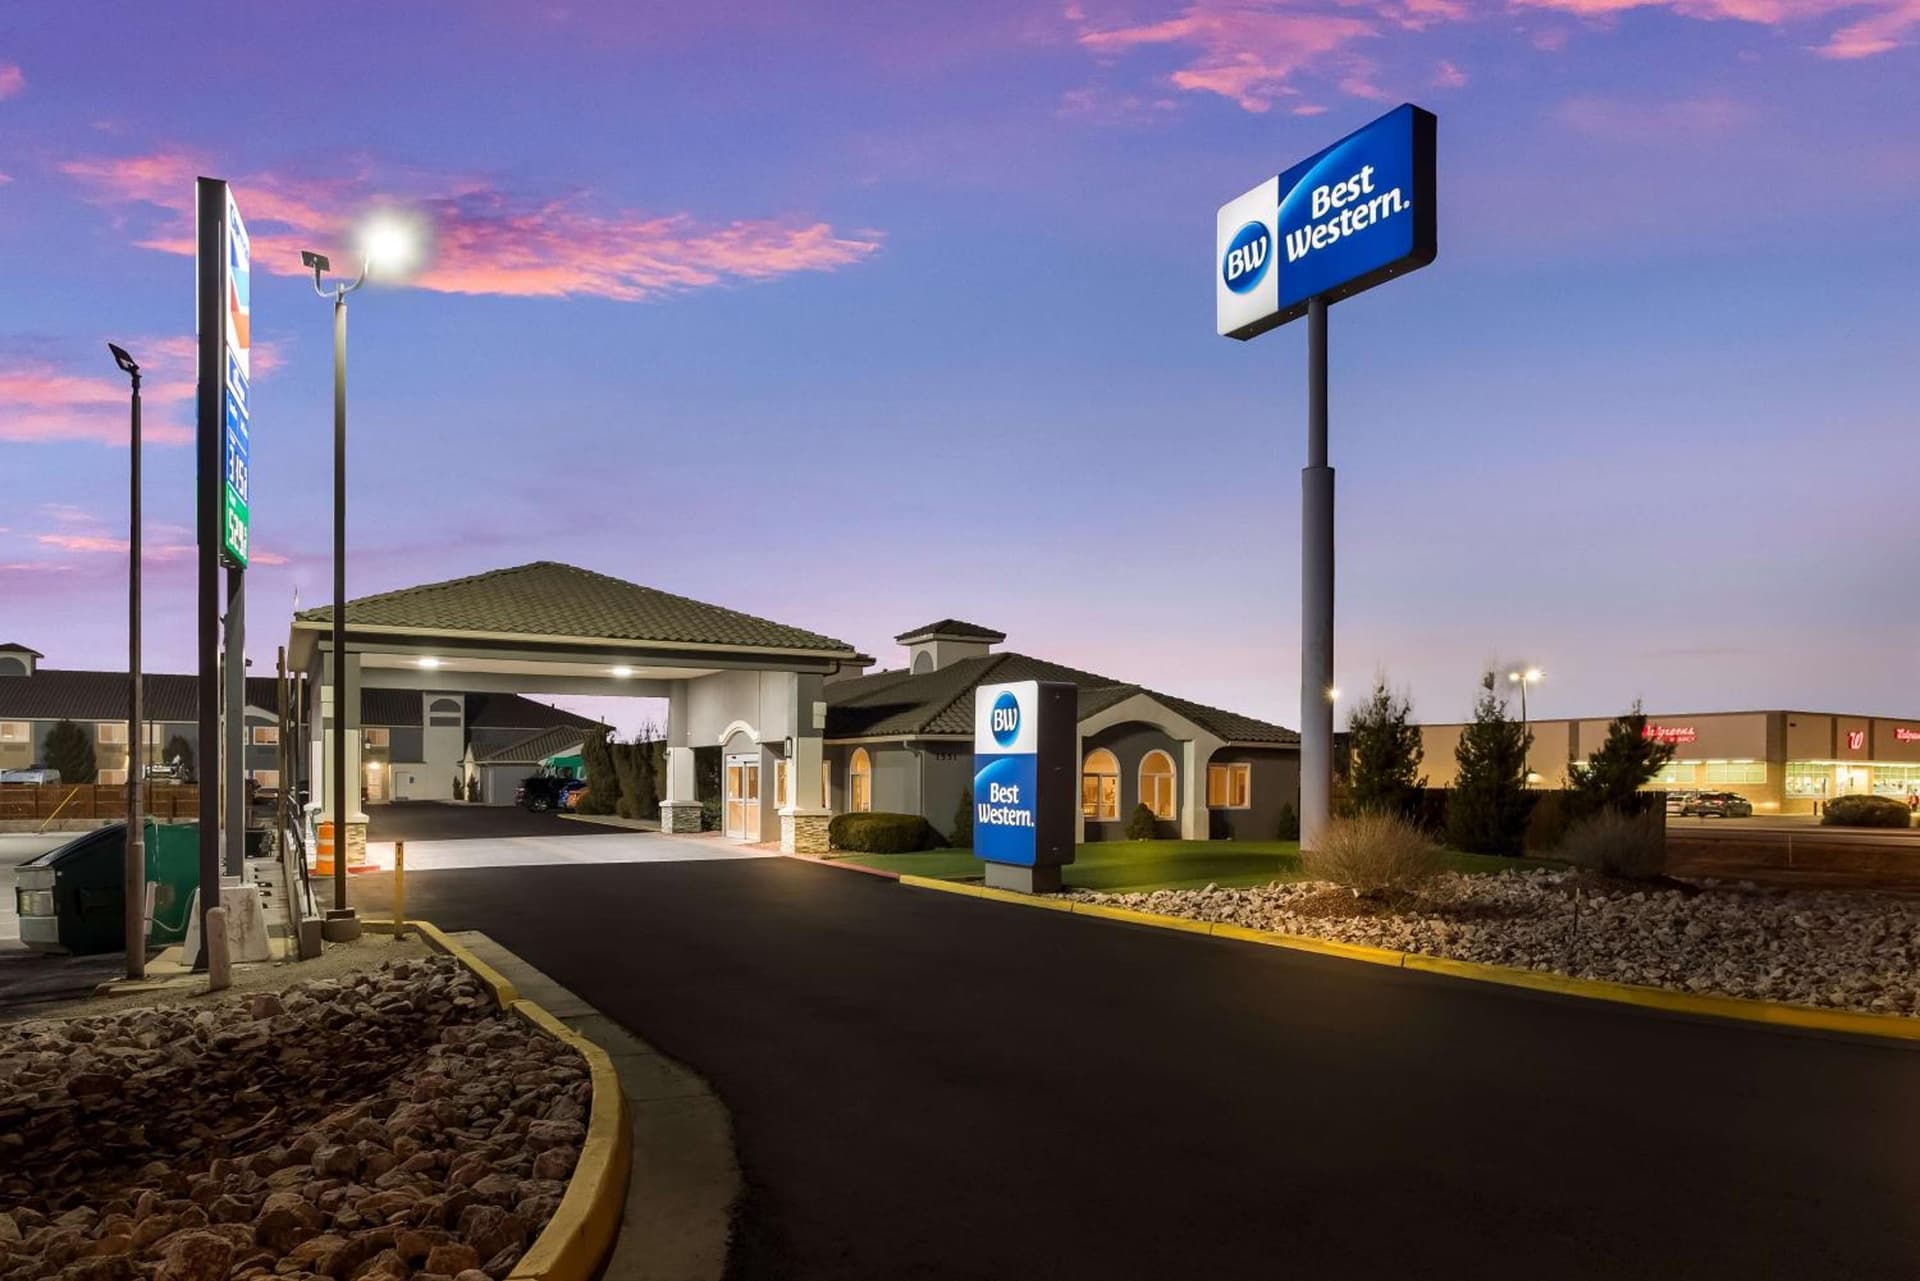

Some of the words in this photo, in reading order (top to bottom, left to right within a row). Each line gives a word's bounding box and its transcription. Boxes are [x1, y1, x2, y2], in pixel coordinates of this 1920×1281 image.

[1312, 165, 1375, 219] Best
[1228, 236, 1267, 281] BW
[994, 709, 1018, 731] BW
[1849, 731, 1864, 750] W
[990, 783, 1019, 804] Best
